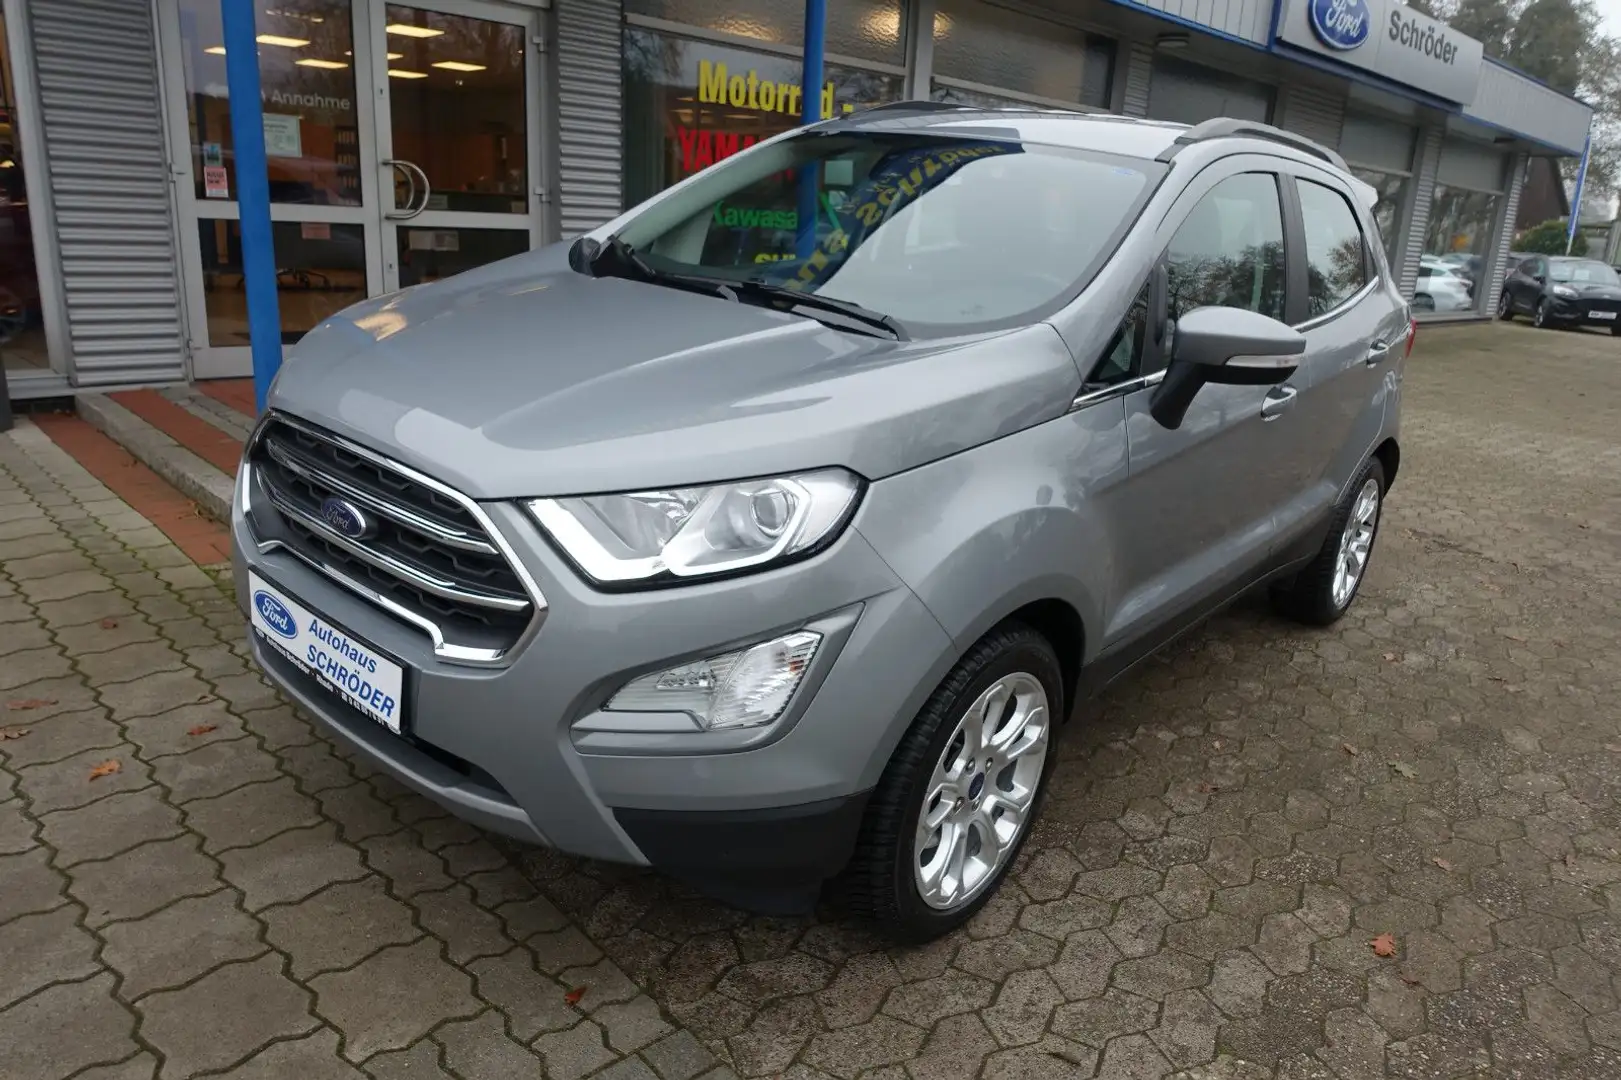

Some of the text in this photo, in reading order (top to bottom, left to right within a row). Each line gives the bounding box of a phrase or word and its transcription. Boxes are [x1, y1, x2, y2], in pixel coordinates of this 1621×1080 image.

[1325, 0, 1364, 38] Ford
[1388, 9, 1458, 66] Schröder
[271, 89, 351, 110] Annahme
[699, 61, 834, 119] Motorrd
[677, 126, 766, 173] YAM
[713, 199, 798, 230] Kawasa
[261, 597, 288, 631] Ford
[308, 618, 377, 674] Autohaus
[307, 644, 395, 718] SCHRÖDER
